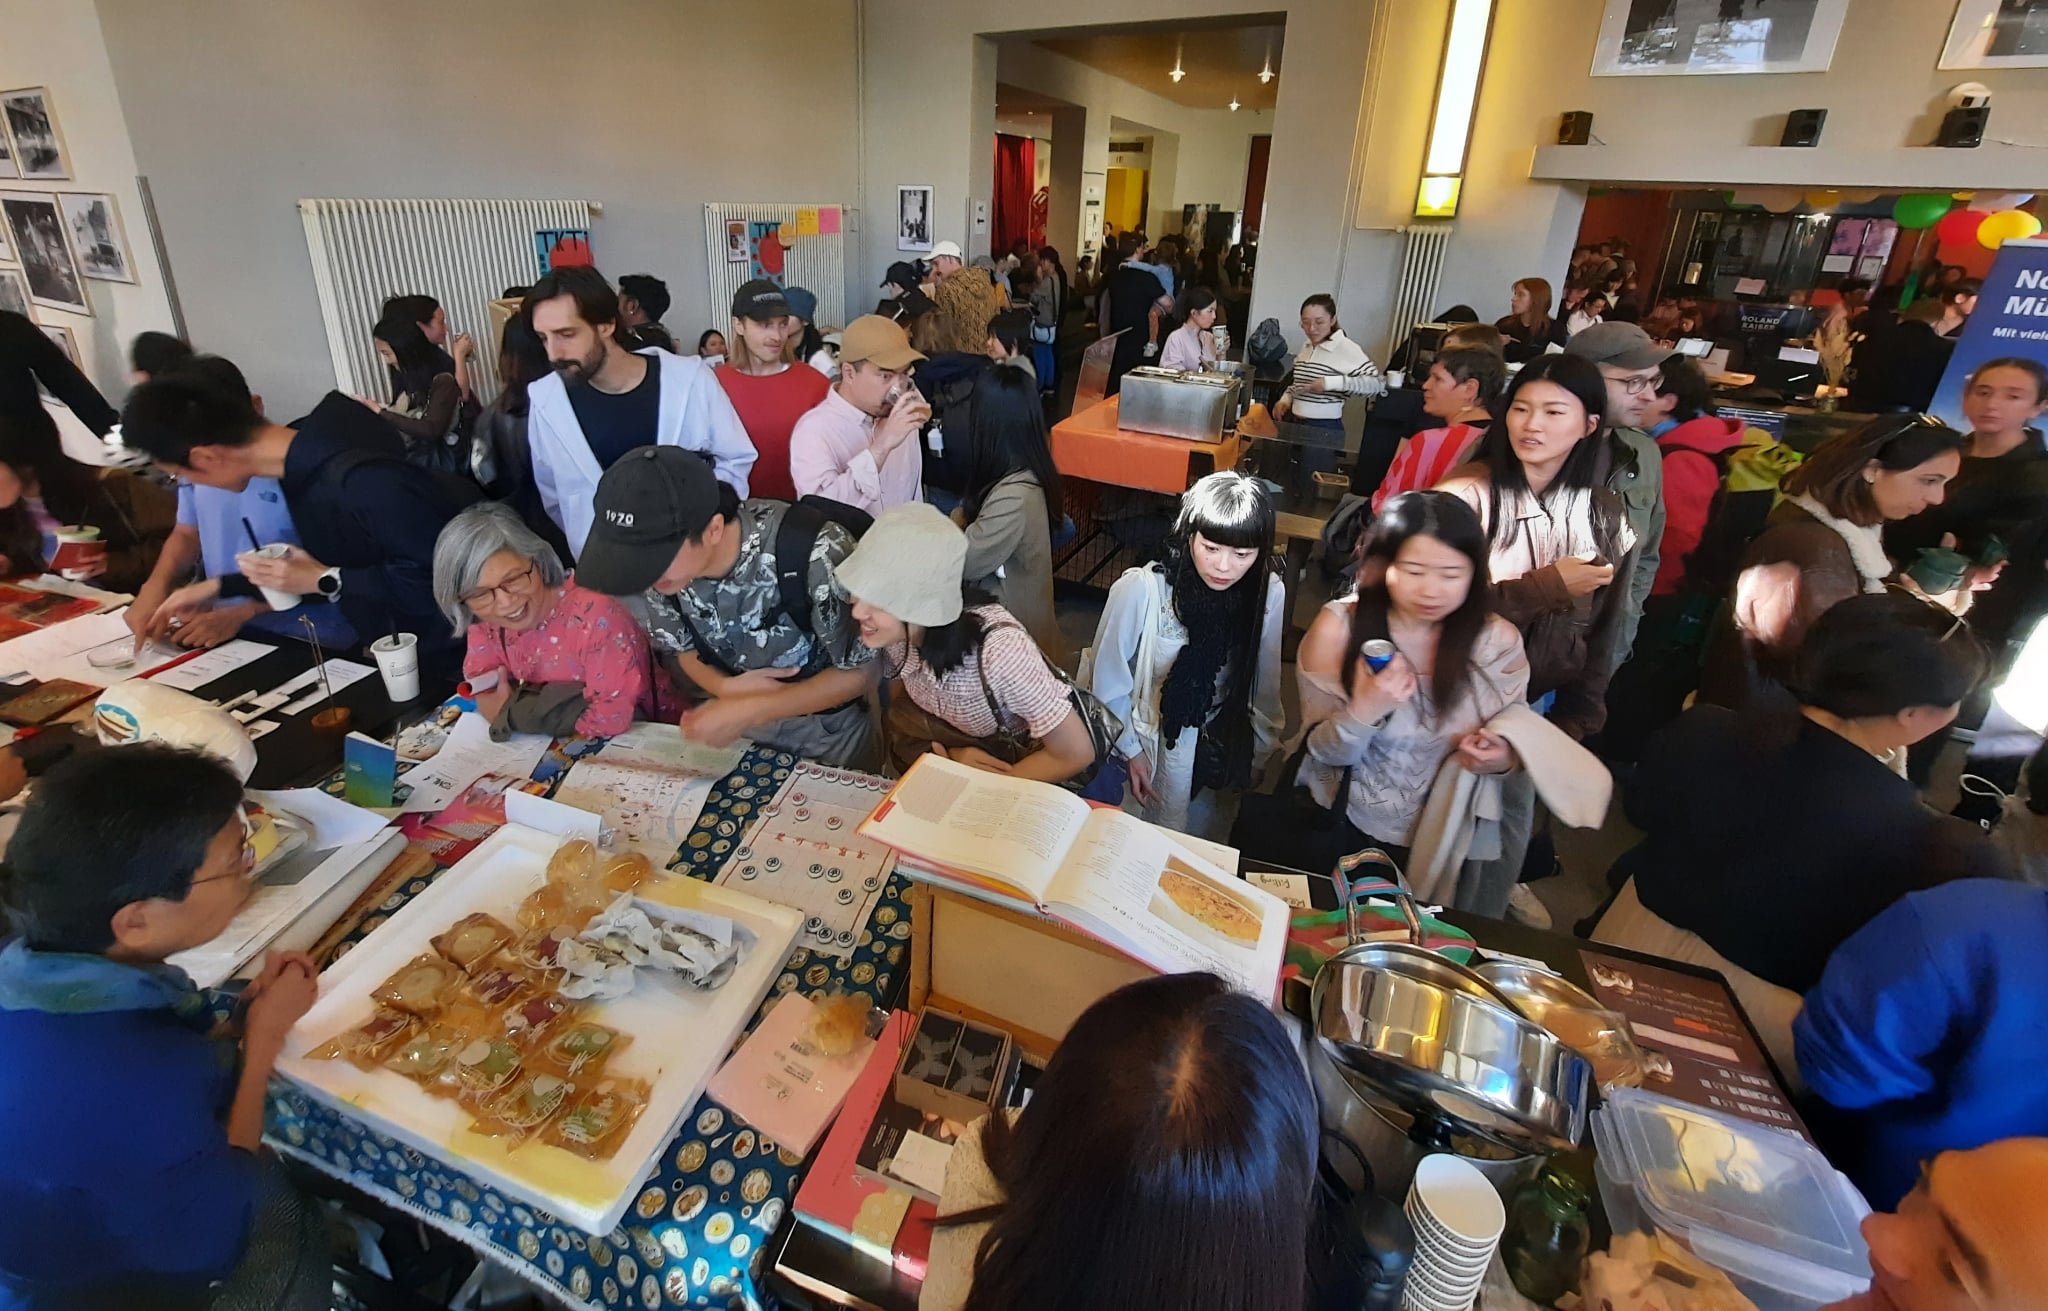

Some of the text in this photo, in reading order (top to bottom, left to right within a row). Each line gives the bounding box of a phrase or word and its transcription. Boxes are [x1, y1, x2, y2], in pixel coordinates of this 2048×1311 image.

[1741, 315, 1780, 325] ROLAND
[1992, 327, 2048, 341] Mit viel
[606, 509, 635, 526] 1970
[1260, 874, 1291, 889] Filling
